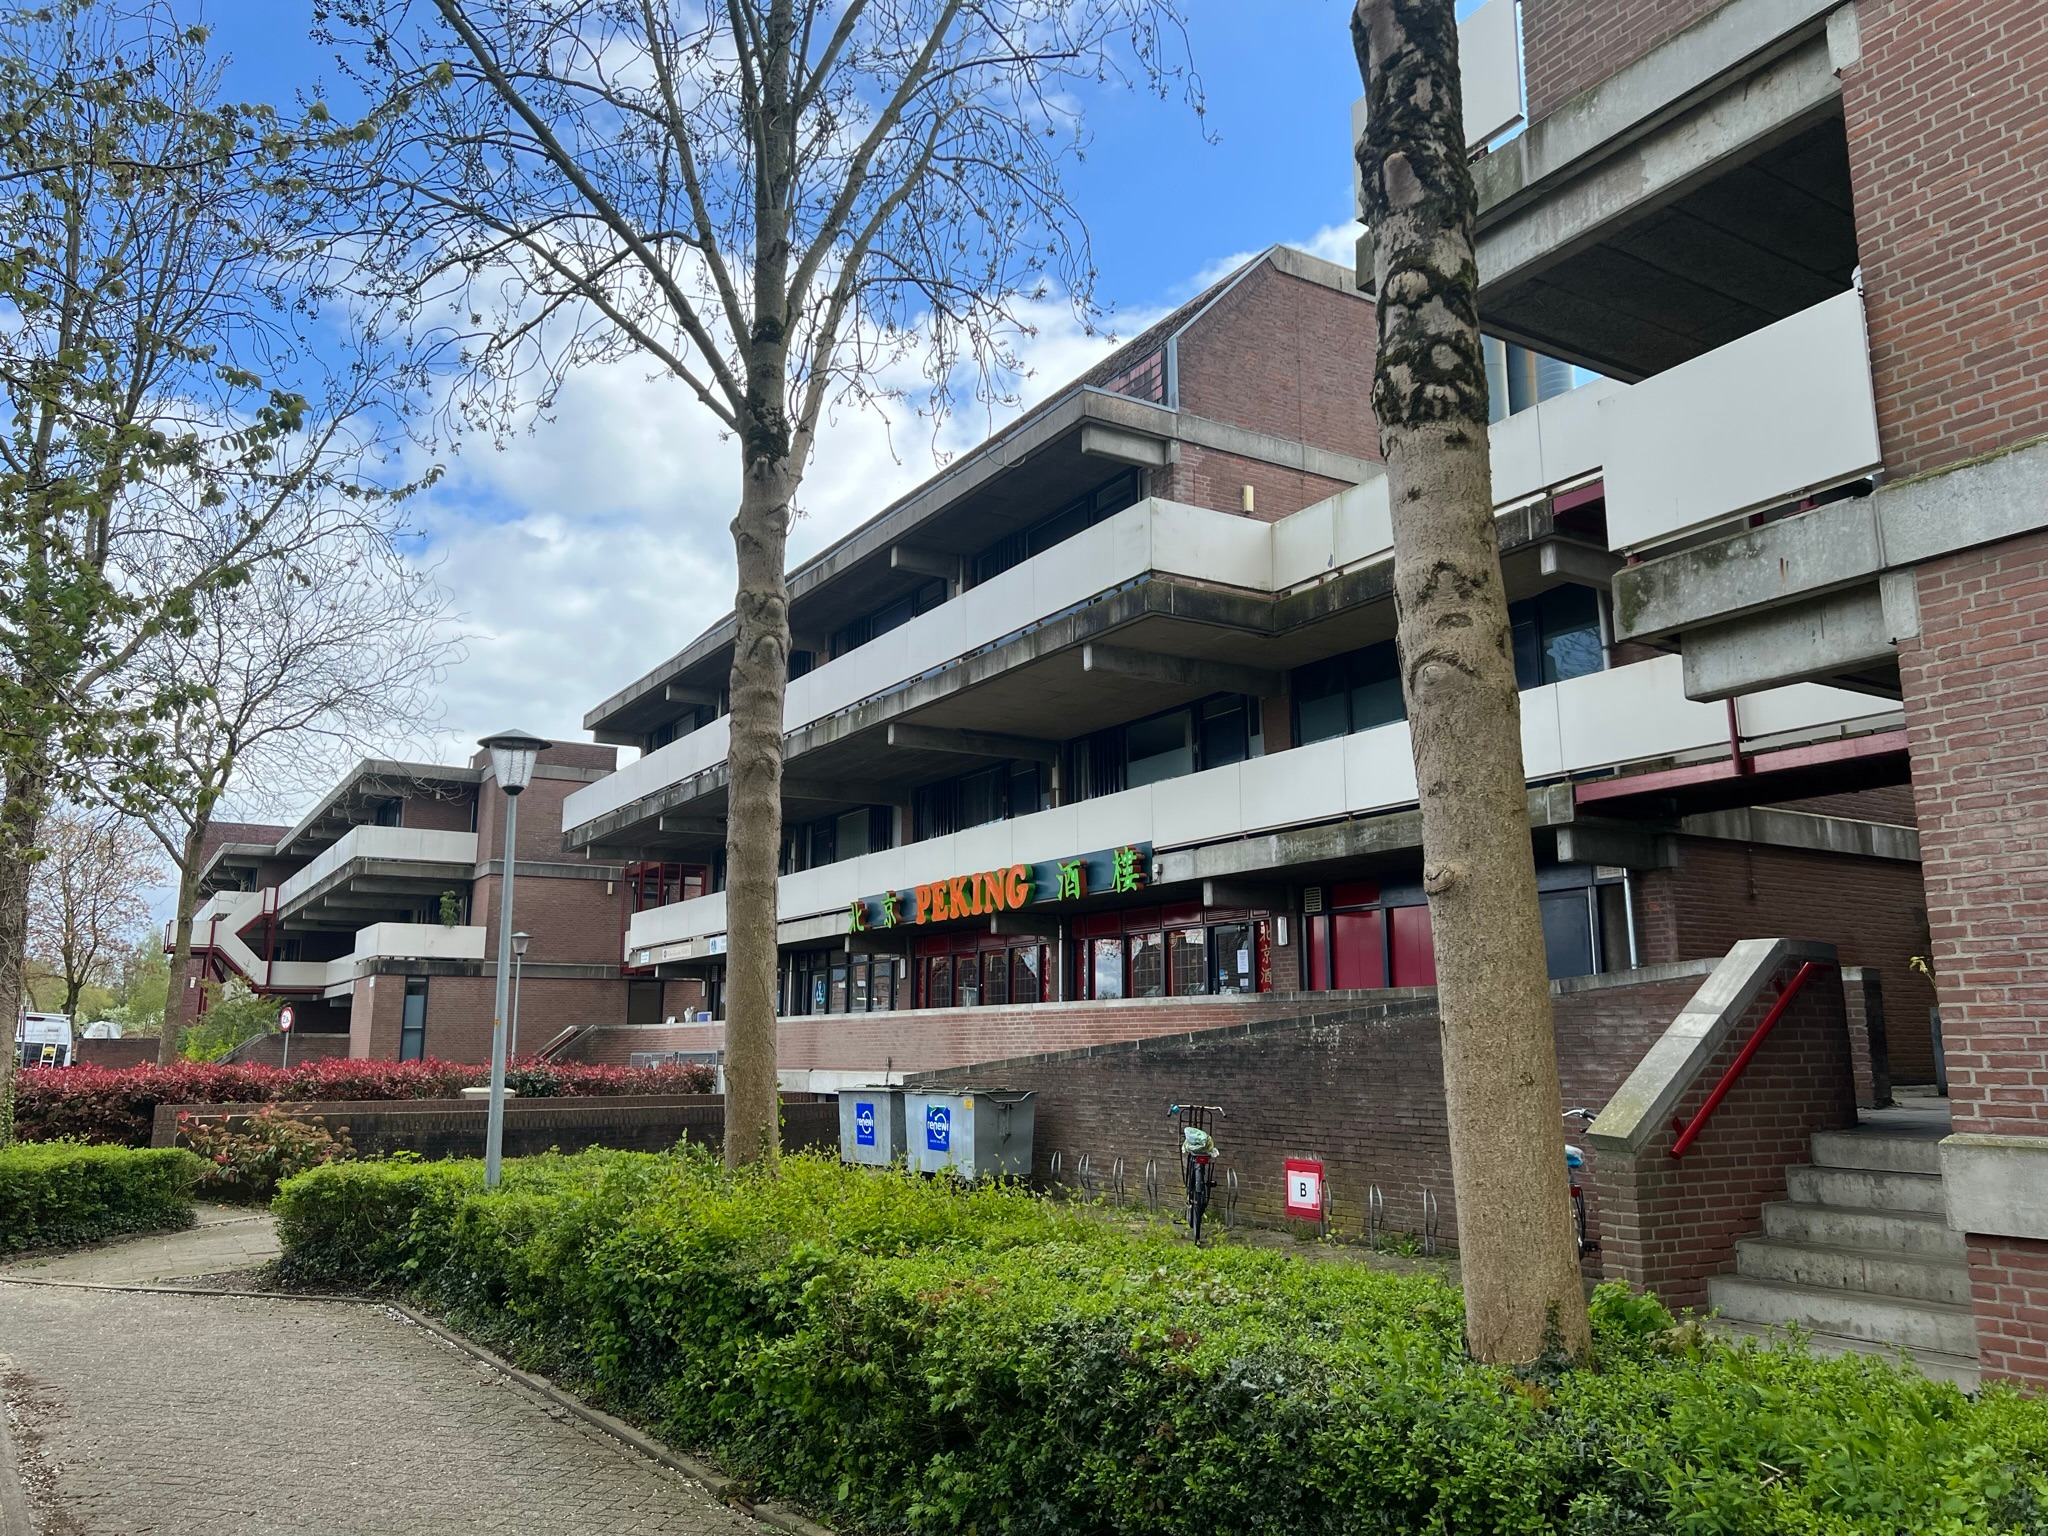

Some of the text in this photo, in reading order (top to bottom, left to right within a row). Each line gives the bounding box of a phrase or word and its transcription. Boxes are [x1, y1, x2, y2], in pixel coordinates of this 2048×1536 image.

[848, 845, 1140, 934] 北京 PEKING 酒樓
[1260, 922, 1272, 993] 北京酒
[856, 1117, 874, 1128] renewi
[927, 1120, 950, 1132] renewi
[1300, 1182, 1307, 1197] B
